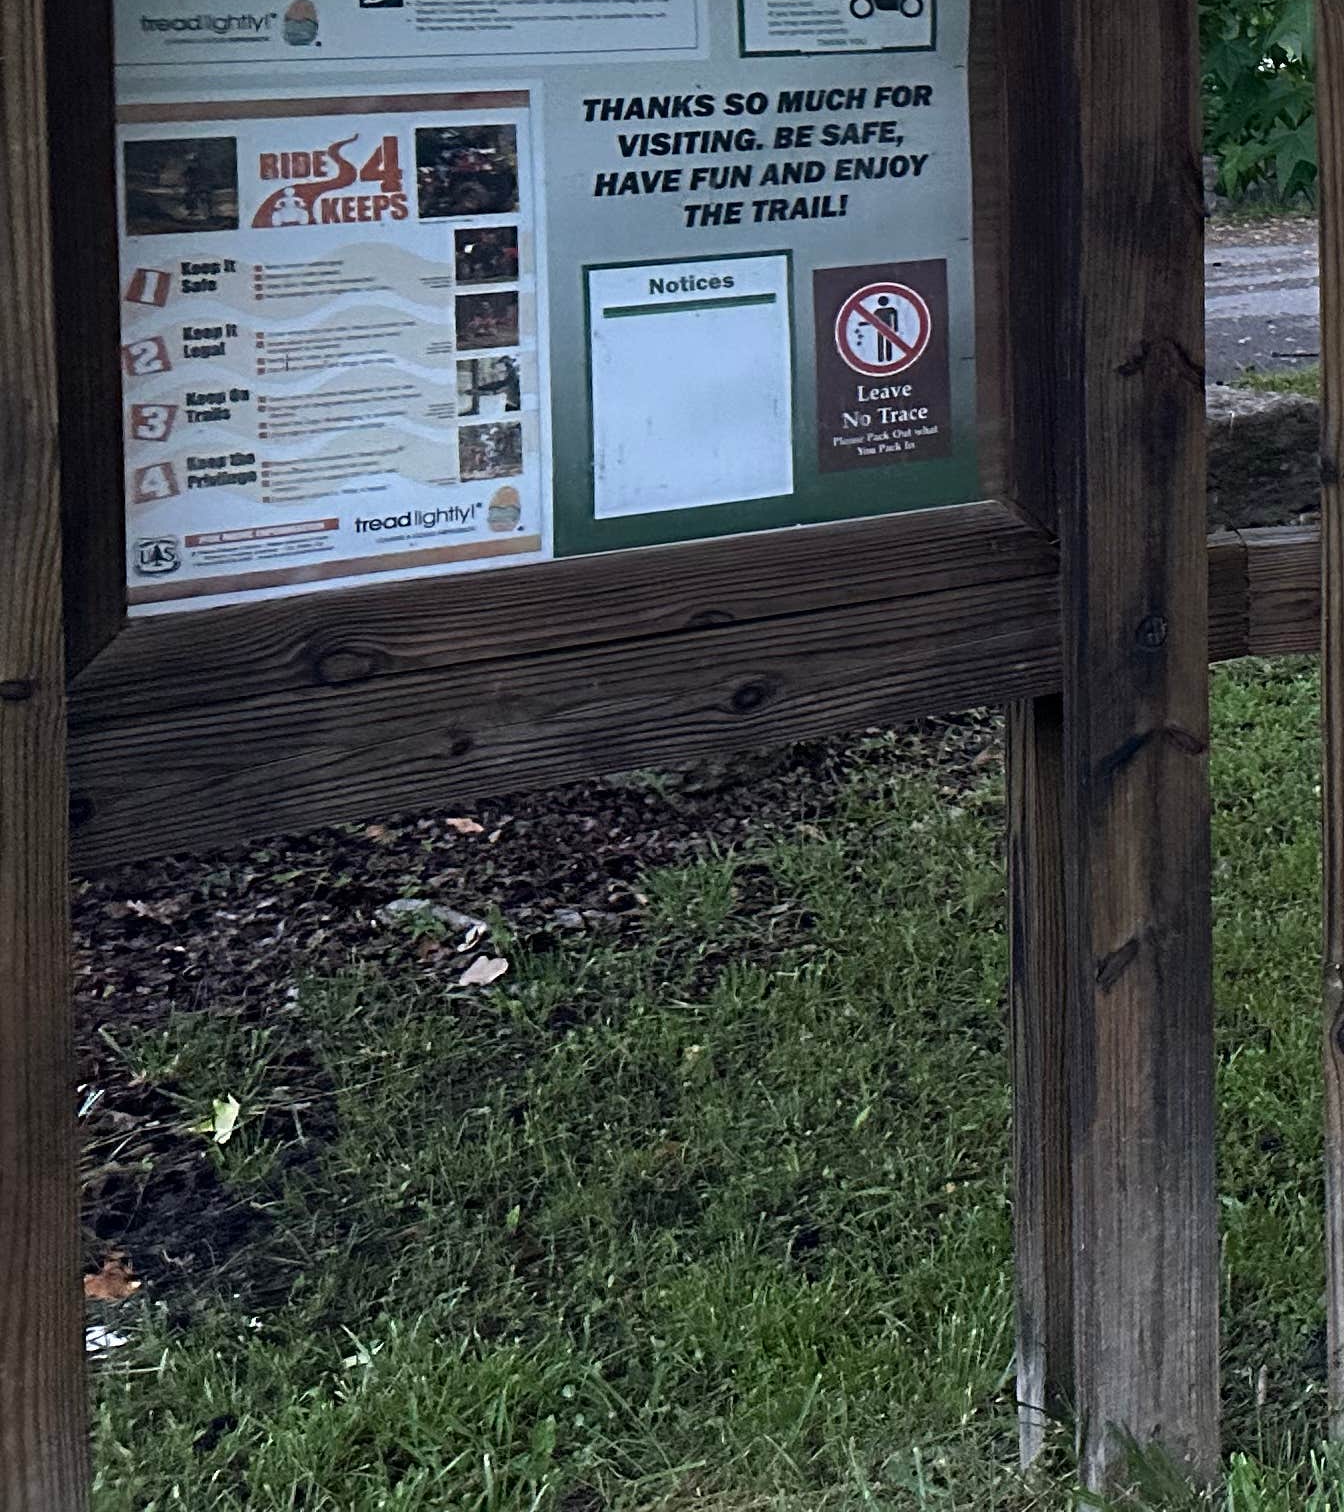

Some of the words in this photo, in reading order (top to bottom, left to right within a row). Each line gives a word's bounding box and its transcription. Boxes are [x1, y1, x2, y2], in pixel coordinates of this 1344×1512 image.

[582, 86, 715, 122] THANKS
[723, 92, 769, 116] SO
[776, 87, 868, 114] MUCH
[874, 85, 933, 109] FOR
[618, 128, 764, 158] VISITING.
[773, 124, 815, 149] BE
[820, 120, 904, 148] SAFE,
[593, 168, 683, 197] HAVE
[689, 164, 753, 191] FUN
[759, 160, 826, 186] AND
[834, 154, 929, 182] ENJOY
[321, 194, 409, 224] KEEPS
[684, 201, 744, 228] THE
[752, 194, 849, 223] TRAIL!
[649, 275, 735, 295] Notices
[857, 384, 912, 402] Leave
[843, 412, 871, 428] No
[877, 407, 929, 424] Trace
